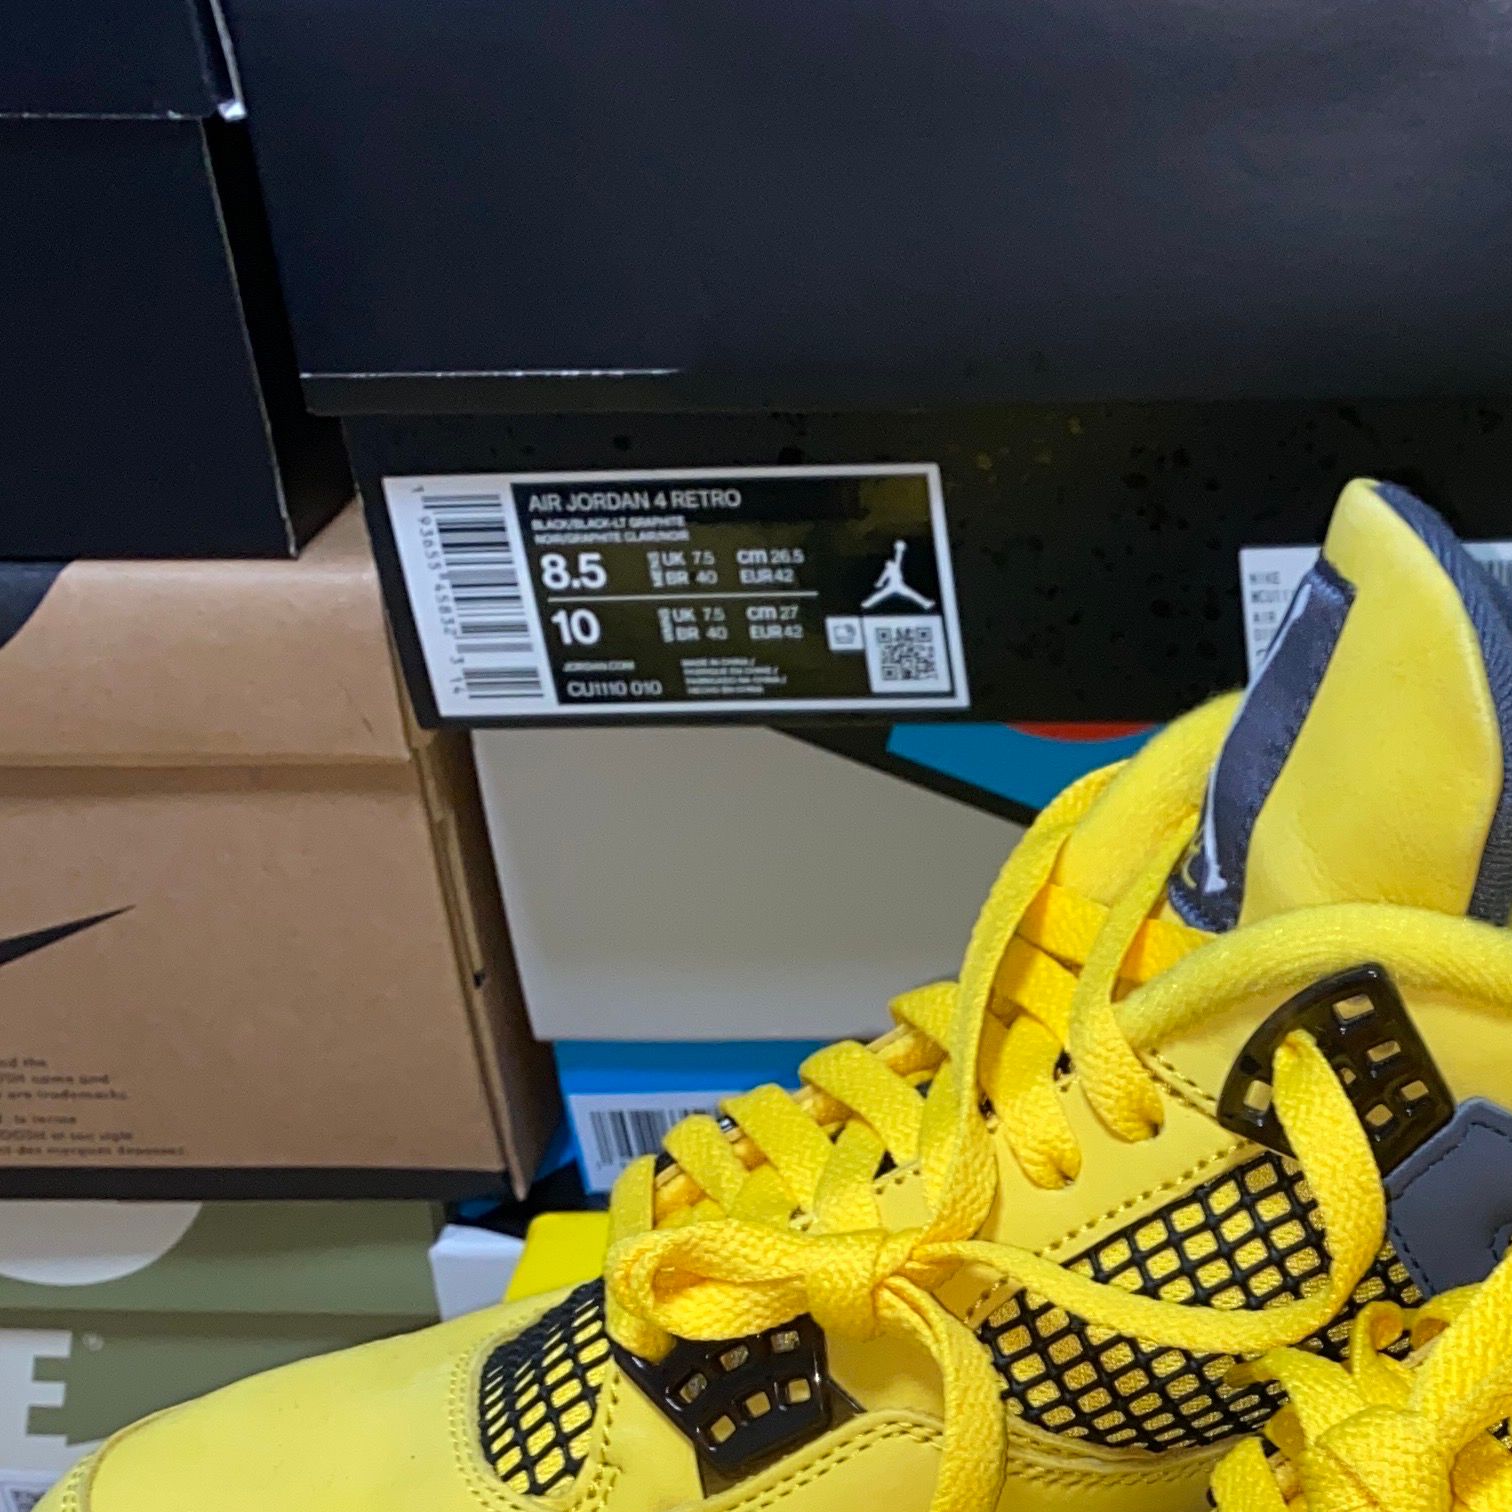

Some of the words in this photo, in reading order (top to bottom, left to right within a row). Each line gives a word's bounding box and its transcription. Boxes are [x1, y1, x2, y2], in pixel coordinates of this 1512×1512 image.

[528, 493, 561, 512] AIR
[565, 490, 650, 512] JORDAN
[653, 491, 667, 508] 4
[670, 488, 742, 509] RETRO
[661, 551, 686, 567] UK
[692, 550, 715, 566] 7.5
[736, 549, 768, 565] cm
[769, 548, 805, 565] 26.5
[539, 552, 607, 590] 8.5
[665, 570, 690, 586] BR
[695, 569, 719, 585] 40
[739, 568, 774, 585] EUR
[774, 568, 796, 584] 42
[672, 607, 697, 623] UK
[702, 607, 726, 622] 7.5
[745, 605, 777, 622] cm
[778, 605, 799, 621] 27
[551, 608, 601, 645] 10
[675, 626, 700, 642] BR
[705, 625, 729, 641] 40
[748, 624, 783, 640] EUR
[783, 624, 804, 640] 42
[567, 680, 628, 698] CU1110
[629, 680, 663, 696] 010
